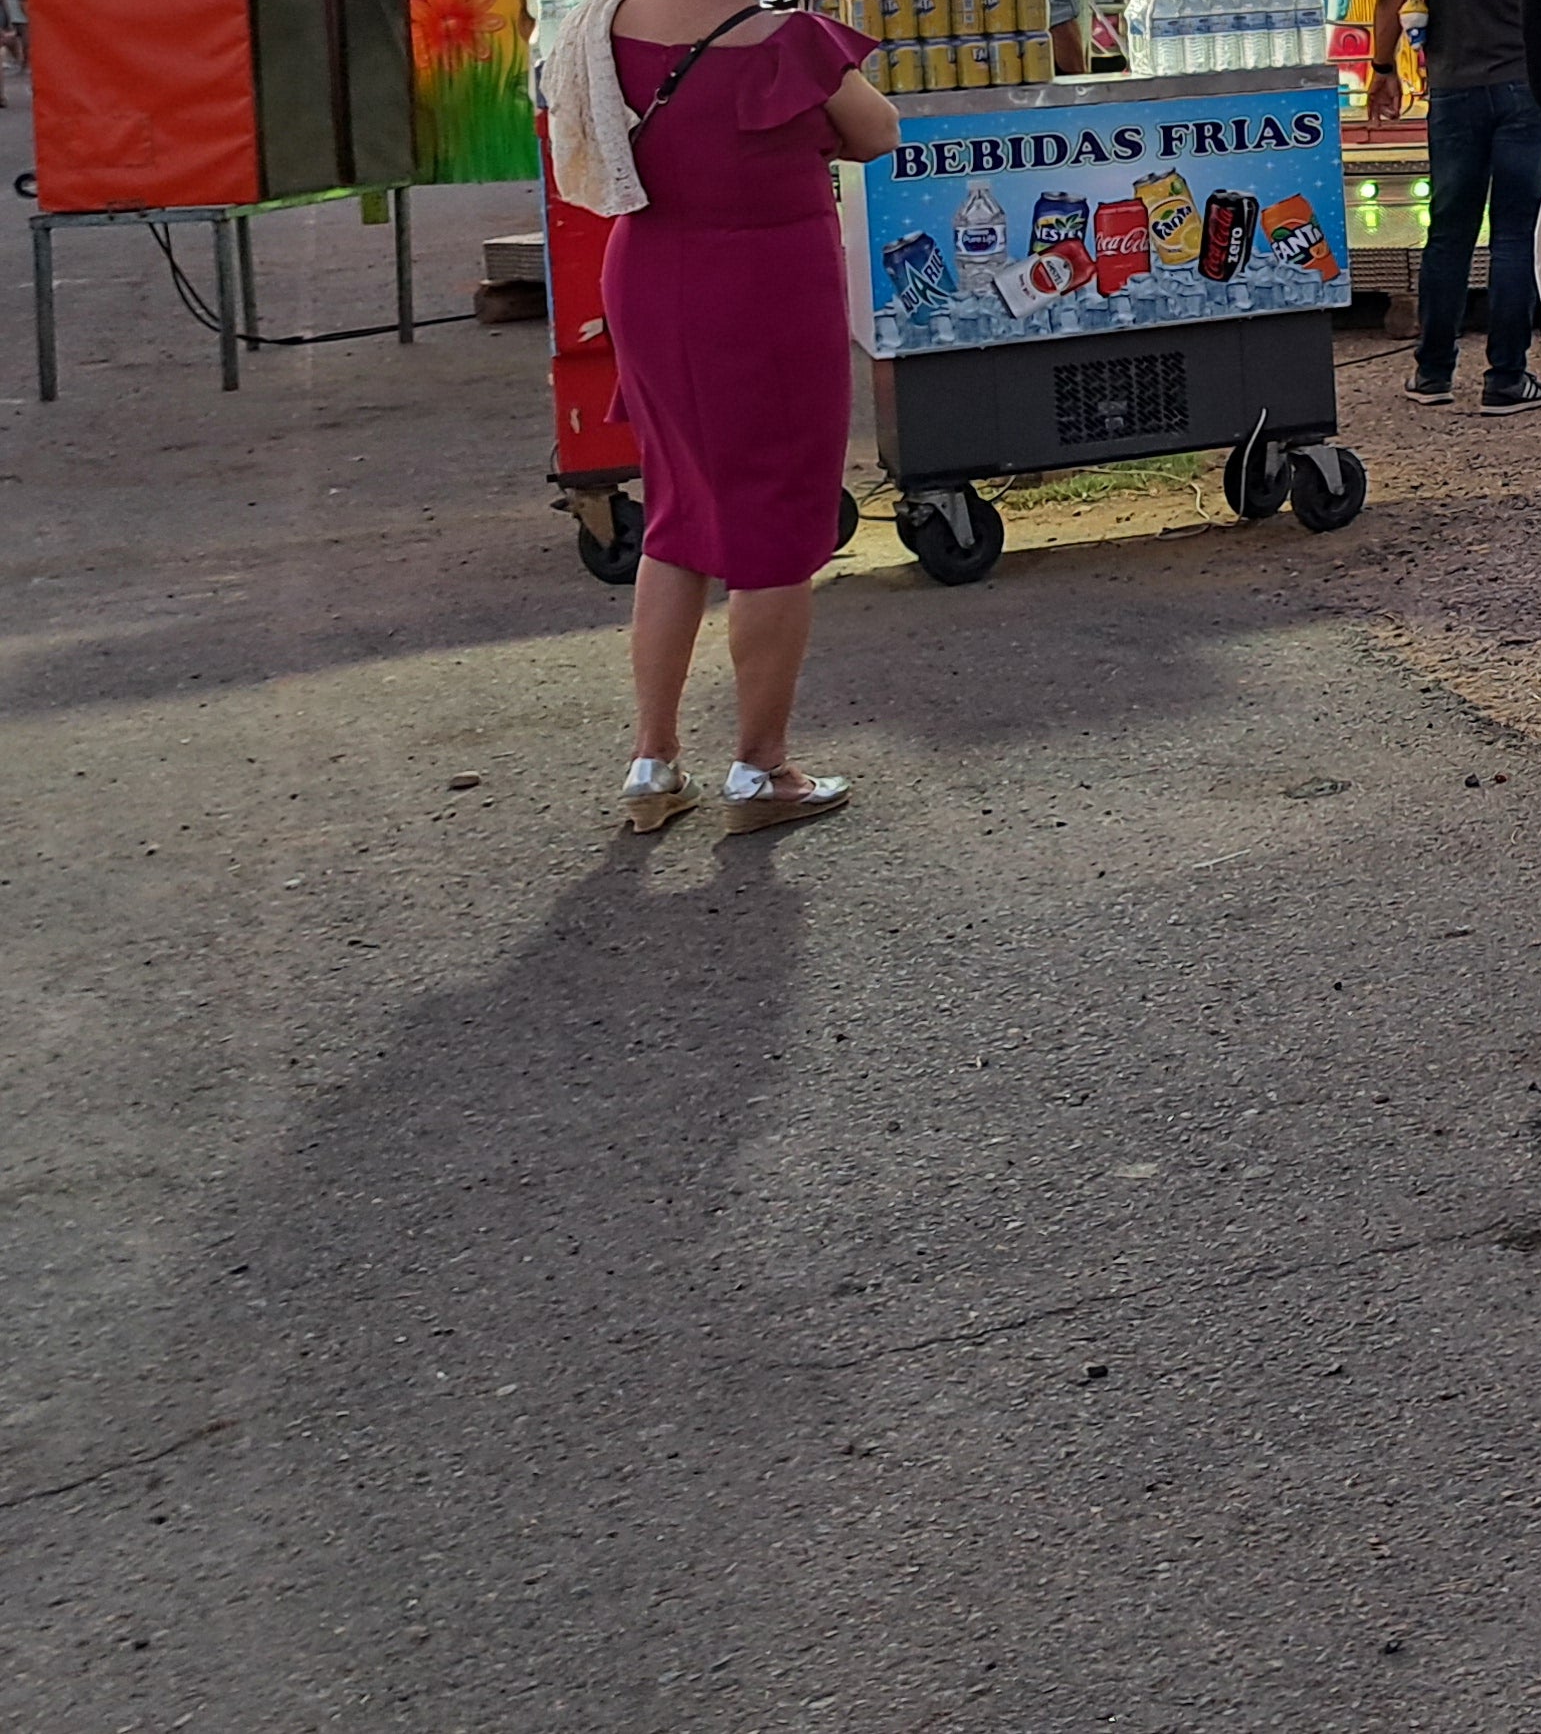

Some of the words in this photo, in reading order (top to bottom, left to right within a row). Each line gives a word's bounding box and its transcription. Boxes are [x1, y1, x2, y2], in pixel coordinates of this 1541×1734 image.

[892, 125, 1144, 182] BEBIDAS
[1156, 111, 1325, 160] FRIAS
[1228, 227, 1243, 263] zero
